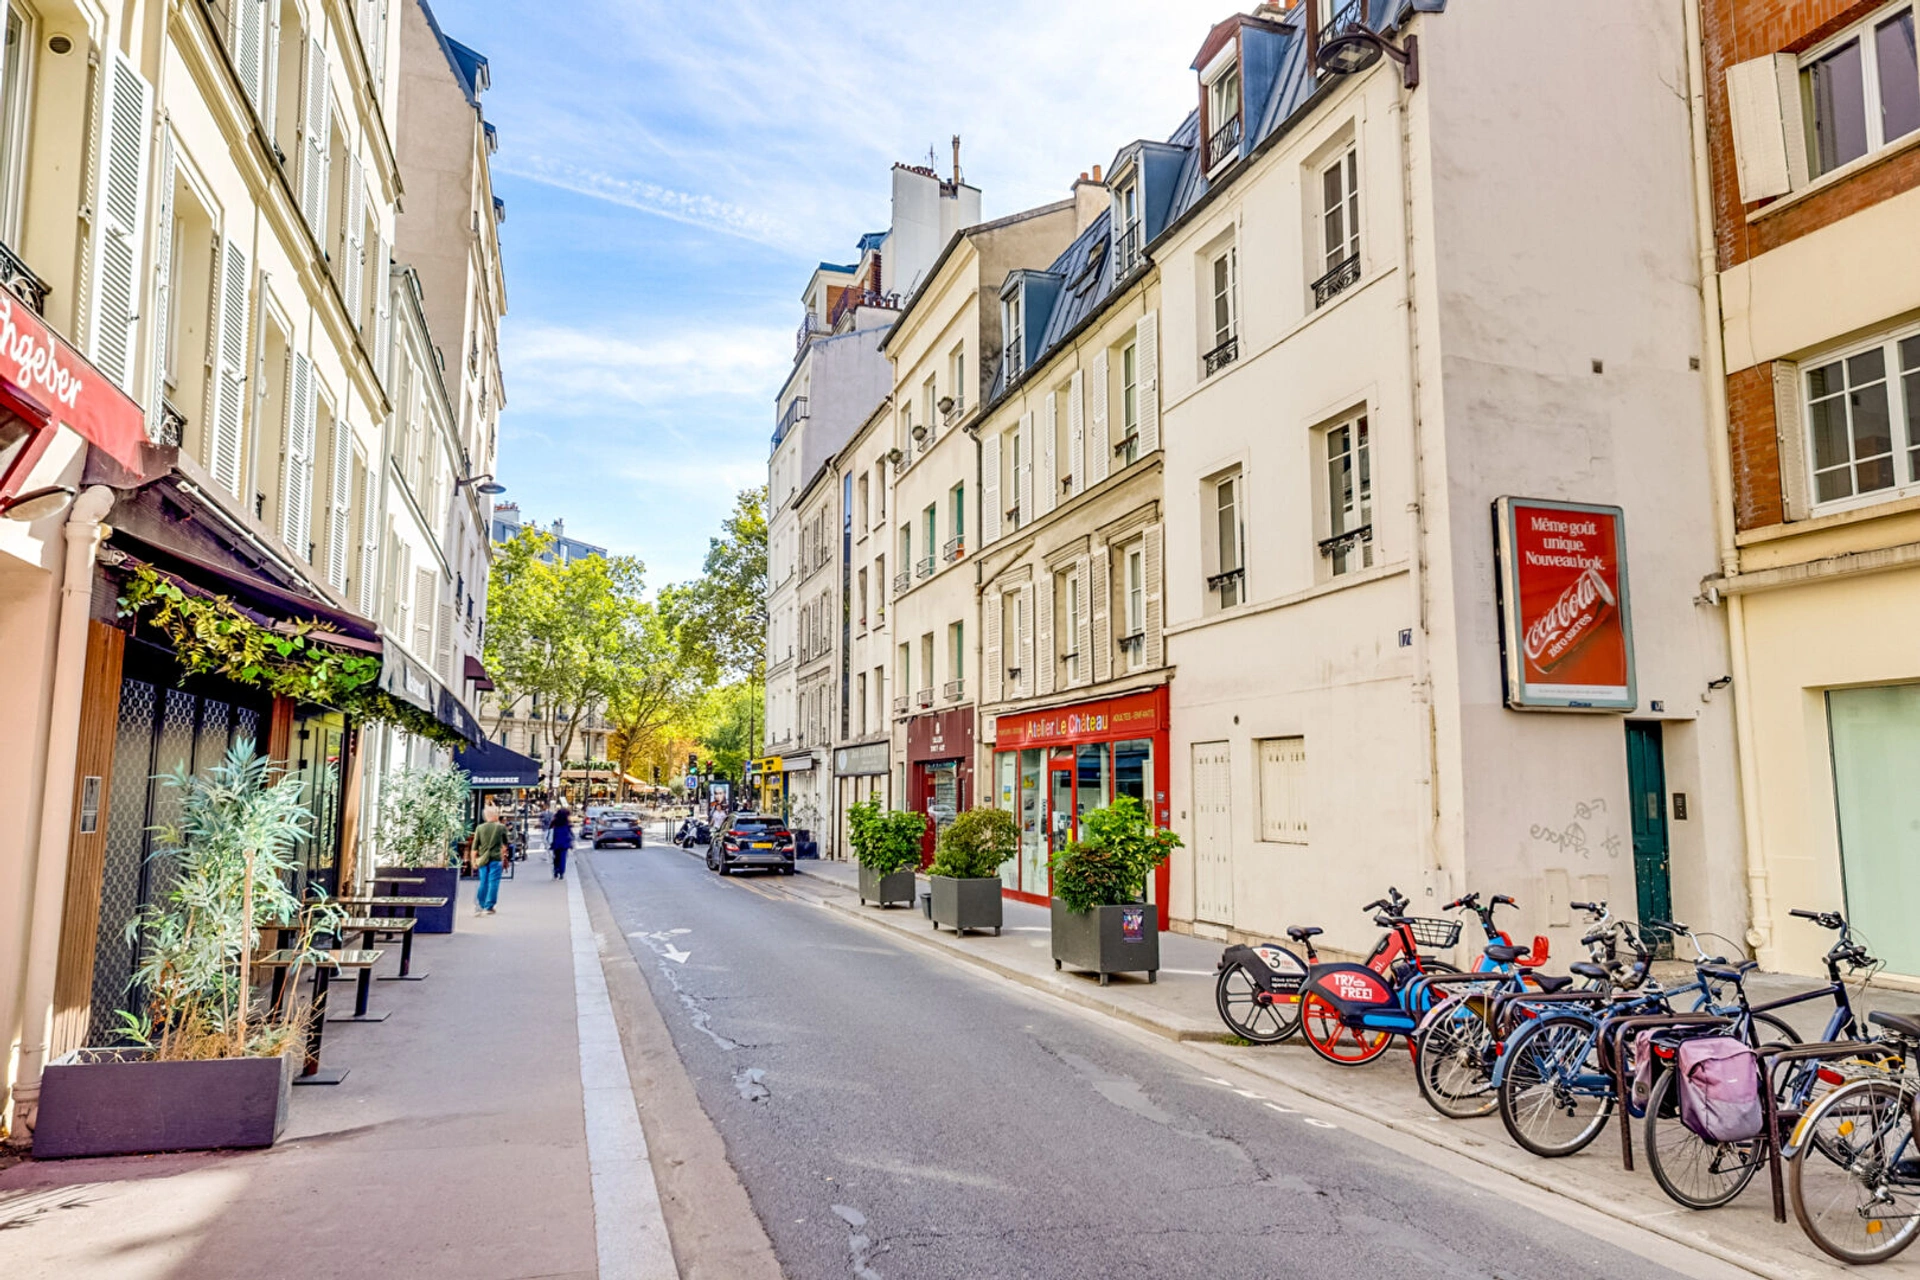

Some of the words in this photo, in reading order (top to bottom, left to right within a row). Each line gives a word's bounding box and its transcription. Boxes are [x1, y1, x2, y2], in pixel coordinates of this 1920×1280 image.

[1531, 516, 1568, 533] Même
[1569, 521, 1597, 537] goût
[1543, 536, 1587, 554] unique.
[1525, 550, 1577, 568] Nouveau
[1577, 554, 1606, 570] look.
[1565, 613, 1593, 641] sucres
[1028, 718, 1055, 738] Atelier
[1055, 716, 1067, 735] Le
[1067, 712, 1109, 734] Château
[1269, 951, 1281, 969] 3
[1333, 973, 1355, 987] TRY
[1340, 986, 1373, 1000] FREE!
